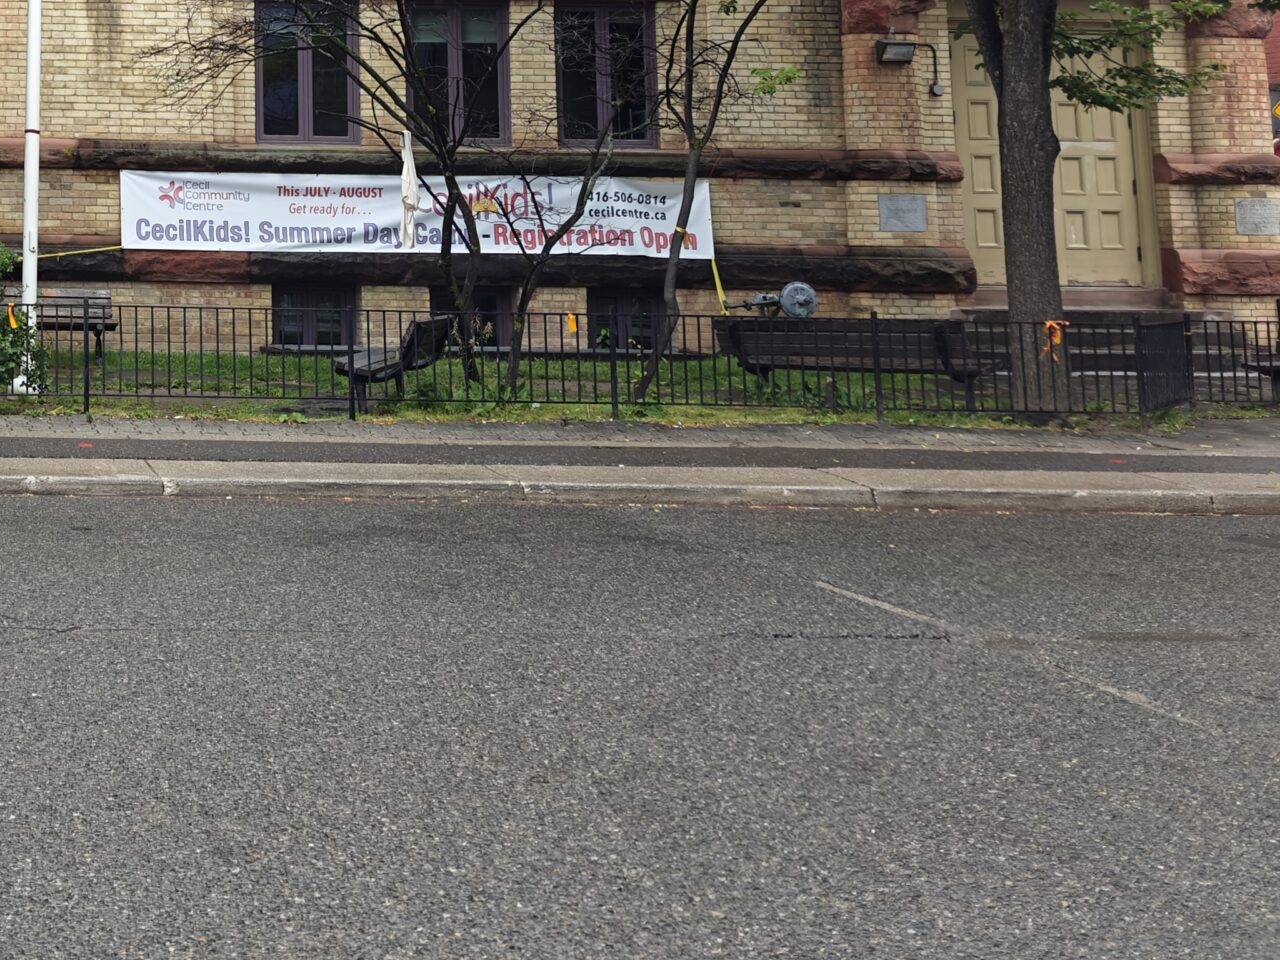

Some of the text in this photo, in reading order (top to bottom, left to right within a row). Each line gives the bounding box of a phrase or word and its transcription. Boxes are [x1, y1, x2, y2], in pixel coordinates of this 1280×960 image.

[185, 180, 210, 190] Cecil
[276, 185, 300, 198] This
[302, 186, 330, 198] JULY
[339, 187, 385, 199] AUGUST
[185, 190, 251, 202] Community
[587, 191, 667, 206] 416-506-0814
[185, 201, 224, 212] Centre
[288, 203, 307, 215] Get
[309, 203, 338, 218] ready
[588, 206, 667, 220] cecilcentre.ca
[135, 218, 251, 243] CecilKids!
[258, 220, 356, 245] Summer
[363, 222, 403, 249] Day
[639, 226, 698, 253] Opn
